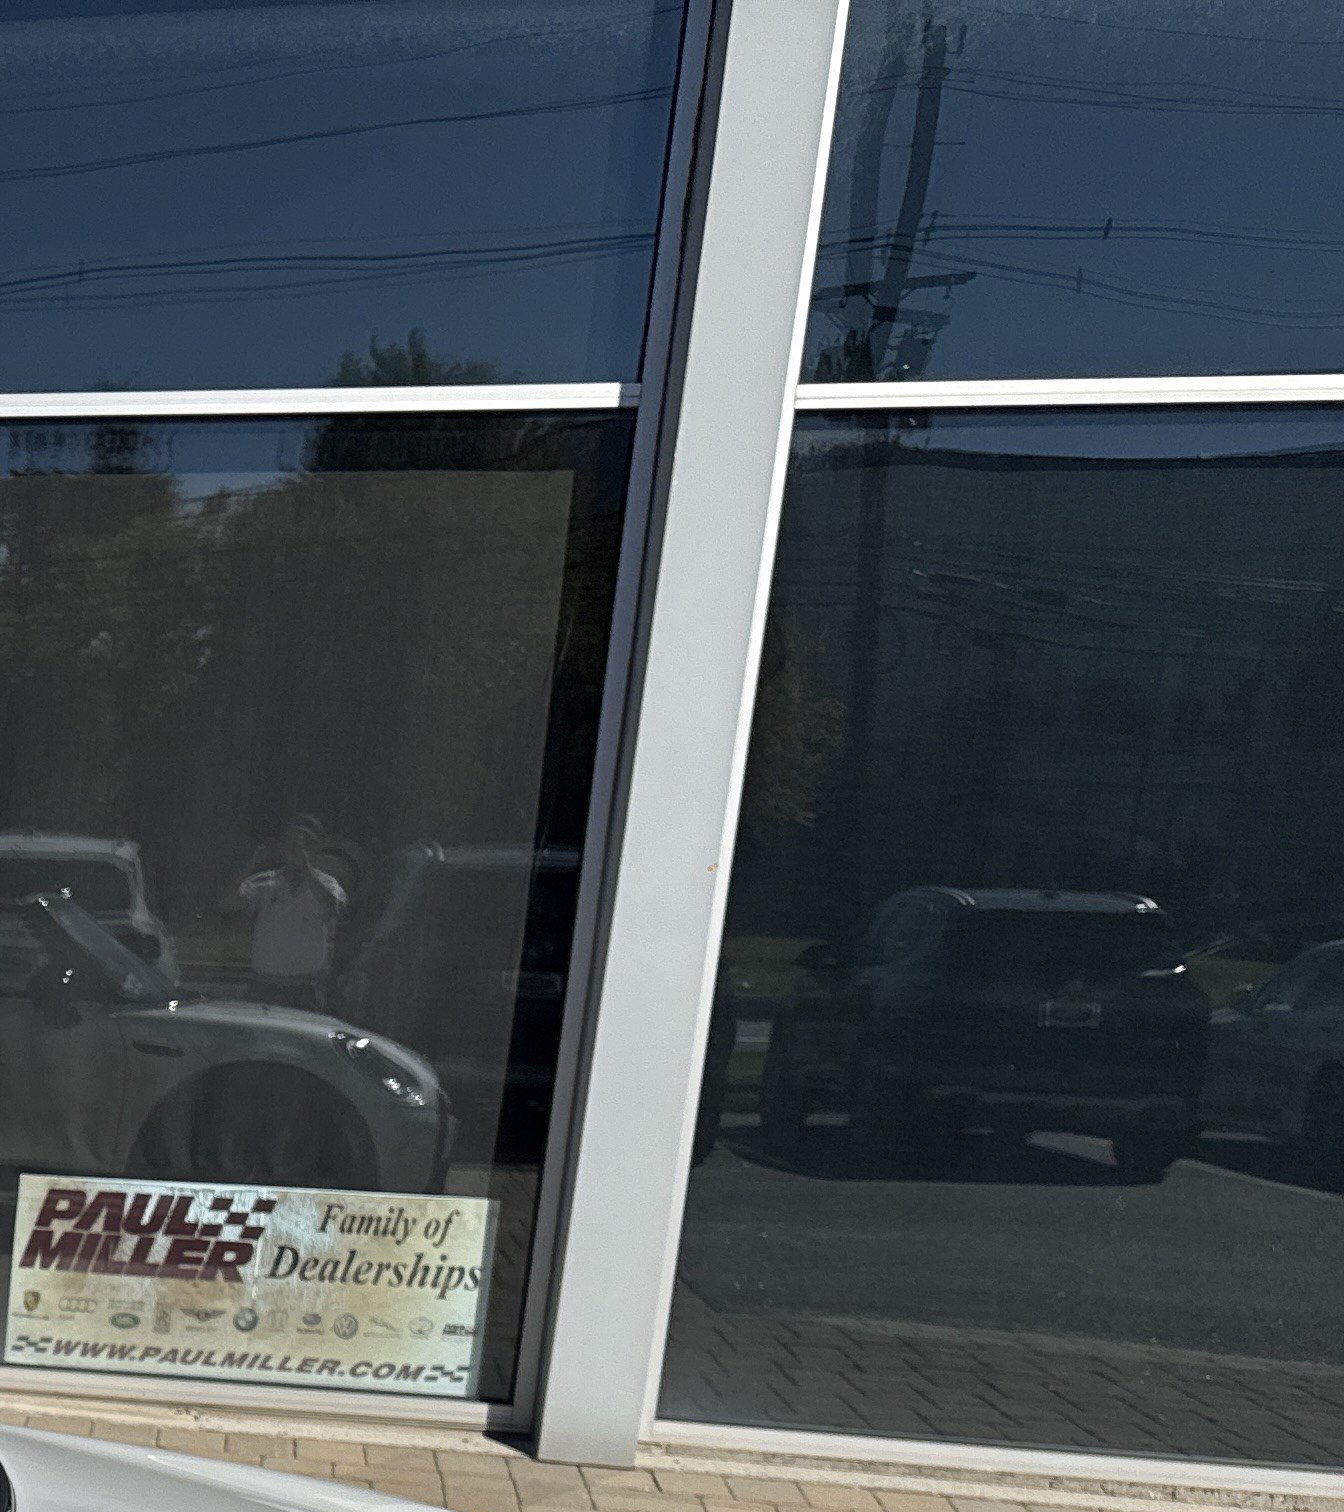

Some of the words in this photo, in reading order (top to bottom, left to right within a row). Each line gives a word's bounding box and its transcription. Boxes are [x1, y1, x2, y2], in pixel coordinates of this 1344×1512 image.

[35, 1188, 199, 1237] PAUL
[318, 1202, 417, 1246] Family
[423, 1209, 460, 1248] of
[18, 1229, 254, 1283] MILLER
[264, 1244, 482, 1300] Dealerships
[52, 1339, 426, 1382] WWW.PAULMILLER.COM
